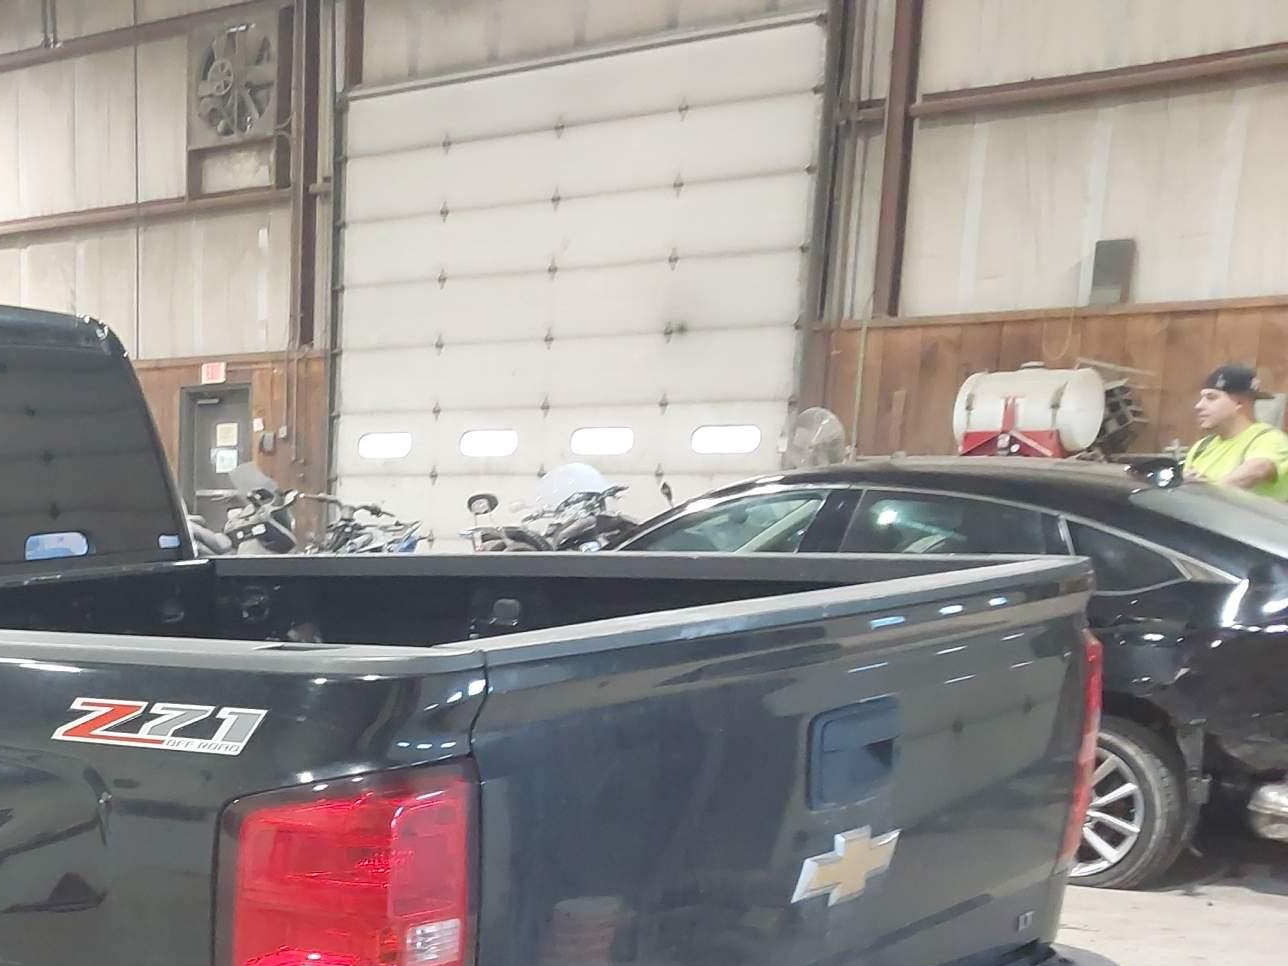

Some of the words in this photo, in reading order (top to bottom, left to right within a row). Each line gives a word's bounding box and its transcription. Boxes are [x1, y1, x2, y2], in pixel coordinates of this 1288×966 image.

[52, 698, 268, 746] Z71
[166, 739, 194, 749] OFF
[197, 741, 241, 752] ROAD
